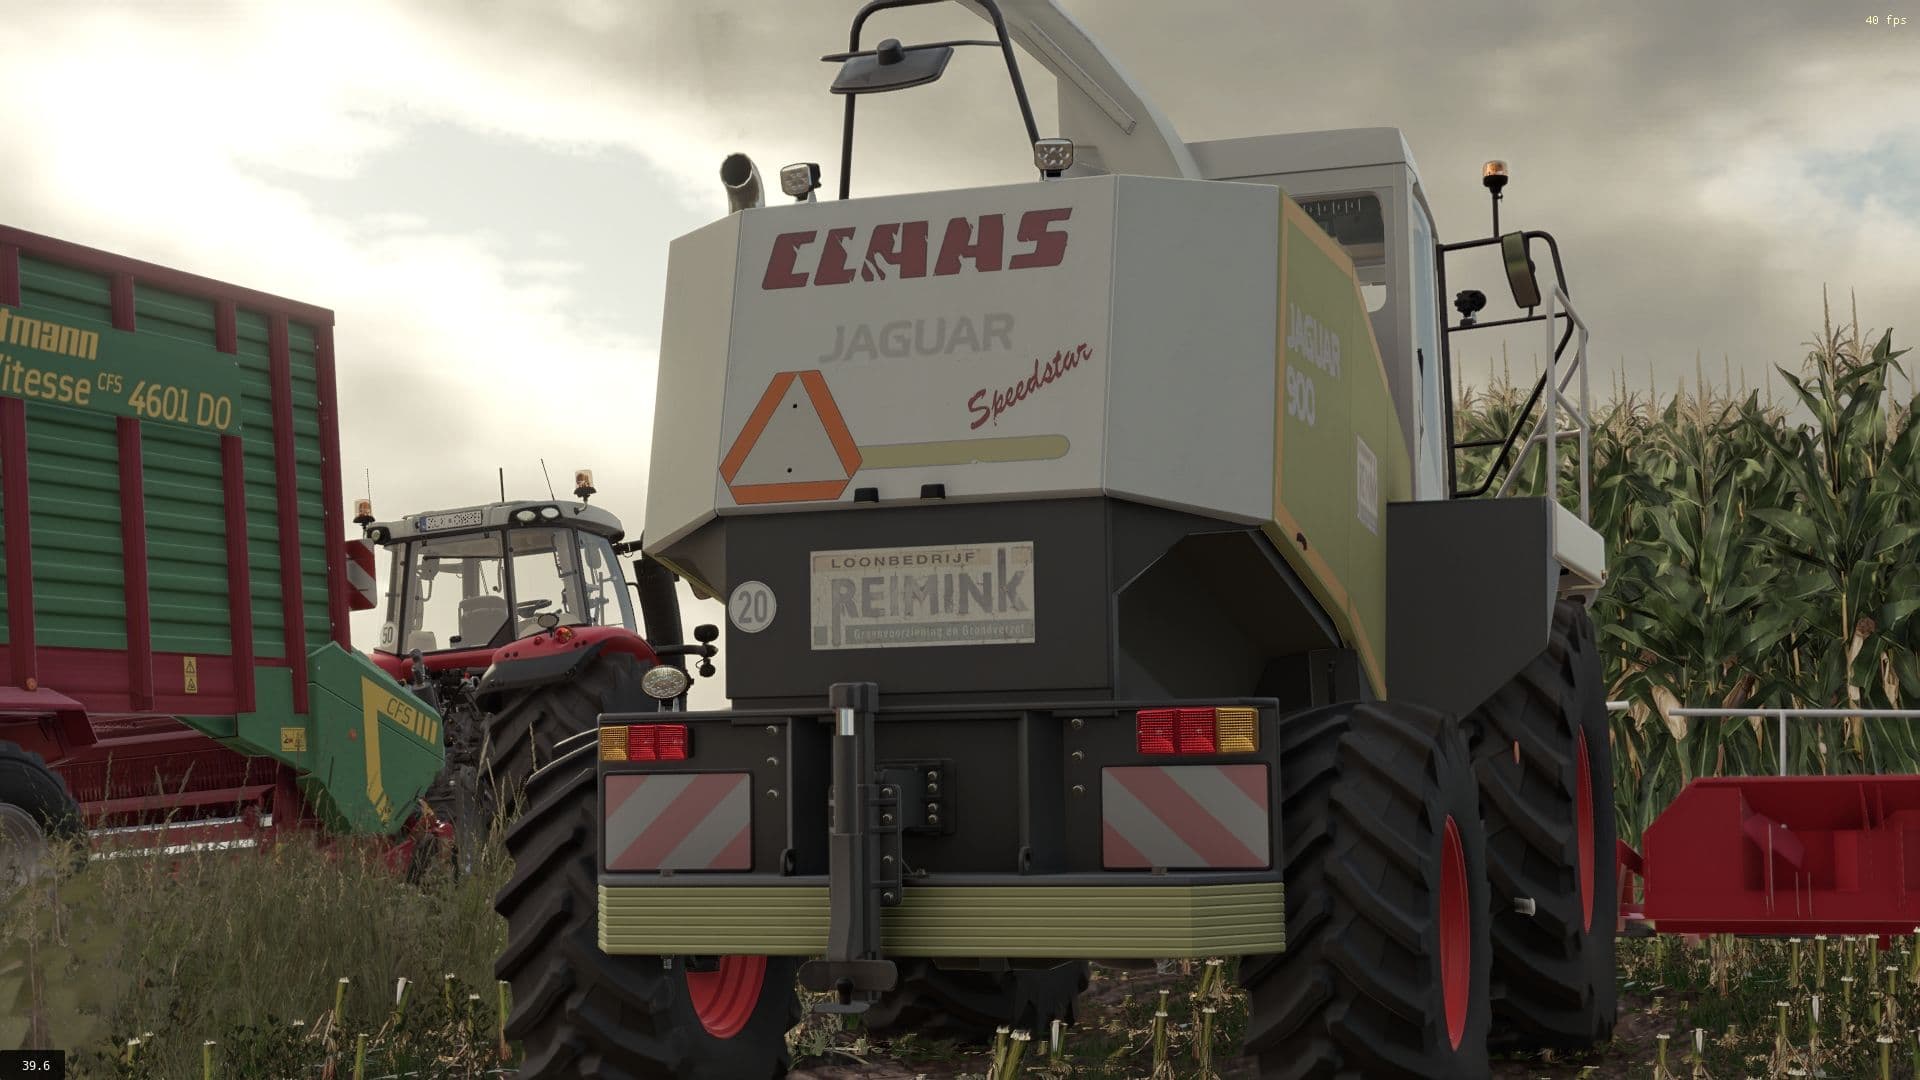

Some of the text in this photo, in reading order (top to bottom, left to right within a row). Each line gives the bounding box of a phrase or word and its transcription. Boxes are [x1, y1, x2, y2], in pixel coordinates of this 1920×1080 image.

[761, 206, 1073, 290] CLAAS
[818, 311, 1015, 365] JAGUAR
[1287, 302, 1340, 380] JAGUAR
[0, 353, 91, 405] itesse
[97, 372, 122, 394] CFS
[128, 380, 189, 423] 4601
[967, 342, 1093, 430] Speedstar
[1286, 364, 1316, 428] 900
[831, 551, 976, 569] LOONBEDRIJF
[738, 589, 767, 625] 20
[854, 624, 942, 641] Grnvoorziening
[382, 626, 394, 645] 50
[386, 697, 412, 725] CFS
